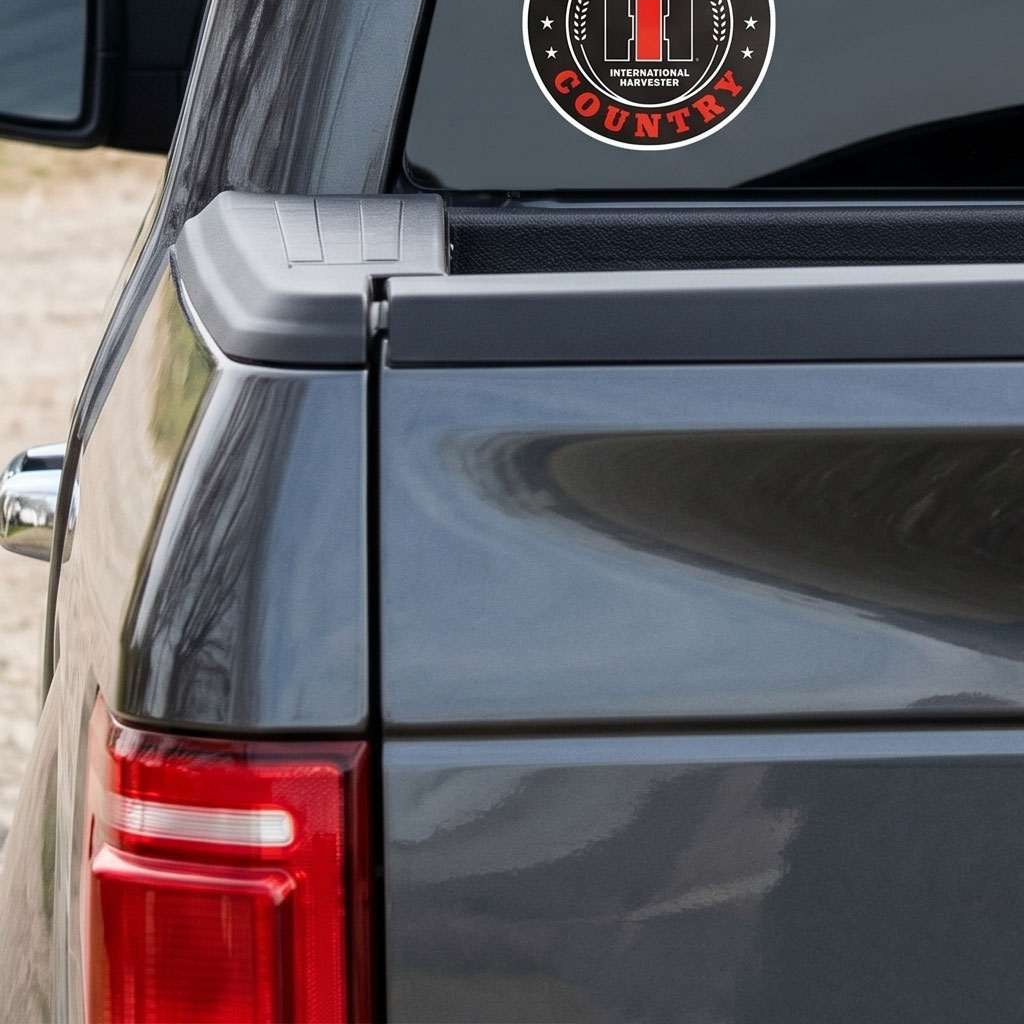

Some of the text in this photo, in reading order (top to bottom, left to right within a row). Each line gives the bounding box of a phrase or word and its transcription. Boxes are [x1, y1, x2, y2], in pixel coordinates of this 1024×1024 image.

[609, 68, 690, 77] INTERNATIONAL
[619, 78, 680, 87] HARVESTER
[554, 70, 743, 138] COUNTRY
